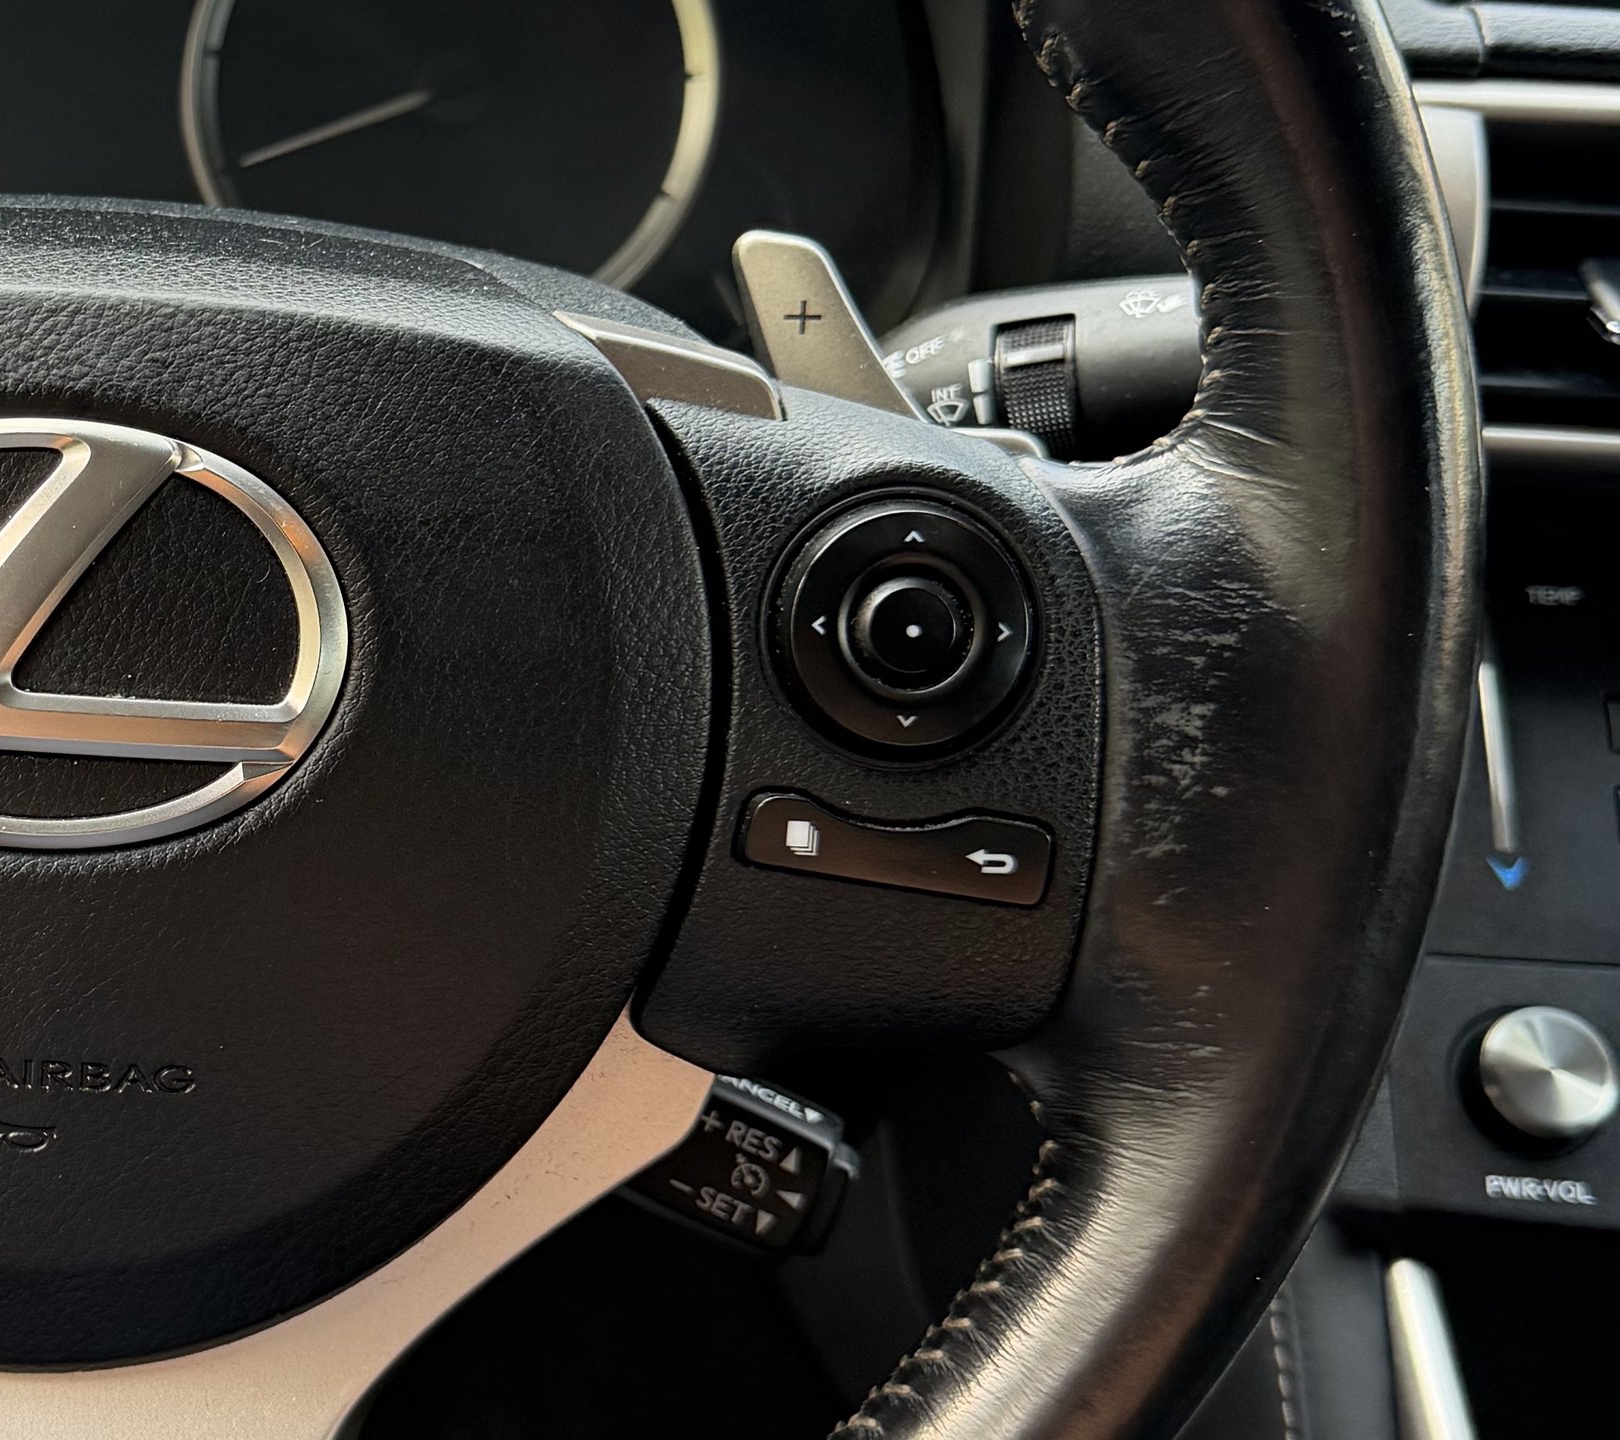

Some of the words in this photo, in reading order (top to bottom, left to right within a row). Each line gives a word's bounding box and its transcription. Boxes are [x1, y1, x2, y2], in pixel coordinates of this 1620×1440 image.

[905, 334, 948, 365] OFF
[931, 382, 963, 404] INT
[716, 1074, 806, 1119] ANCEL
[725, 1120, 784, 1163] RES
[695, 1185, 754, 1226] SET
